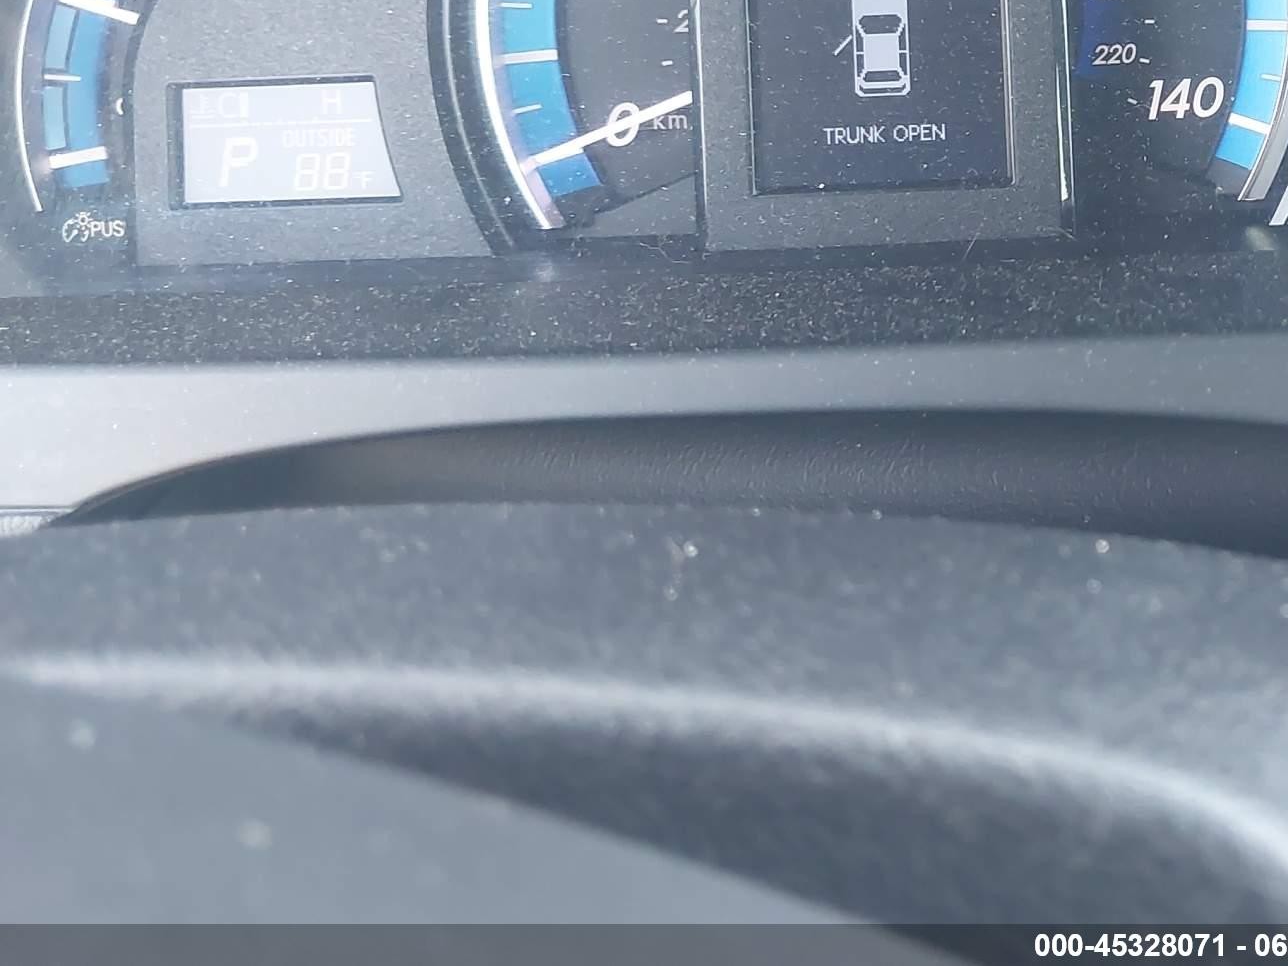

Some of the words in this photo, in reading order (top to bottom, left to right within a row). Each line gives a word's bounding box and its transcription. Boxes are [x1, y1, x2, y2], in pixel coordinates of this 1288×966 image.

[1092, 43, 1137, 66] 220
[321, 89, 344, 115] H
[1147, 76, 1225, 122] 140
[607, 101, 641, 148] 0
[822, 124, 886, 145] TRUNK
[892, 123, 947, 143] OPEN
[282, 127, 356, 149] OUTSIDE
[218, 136, 259, 188] P
